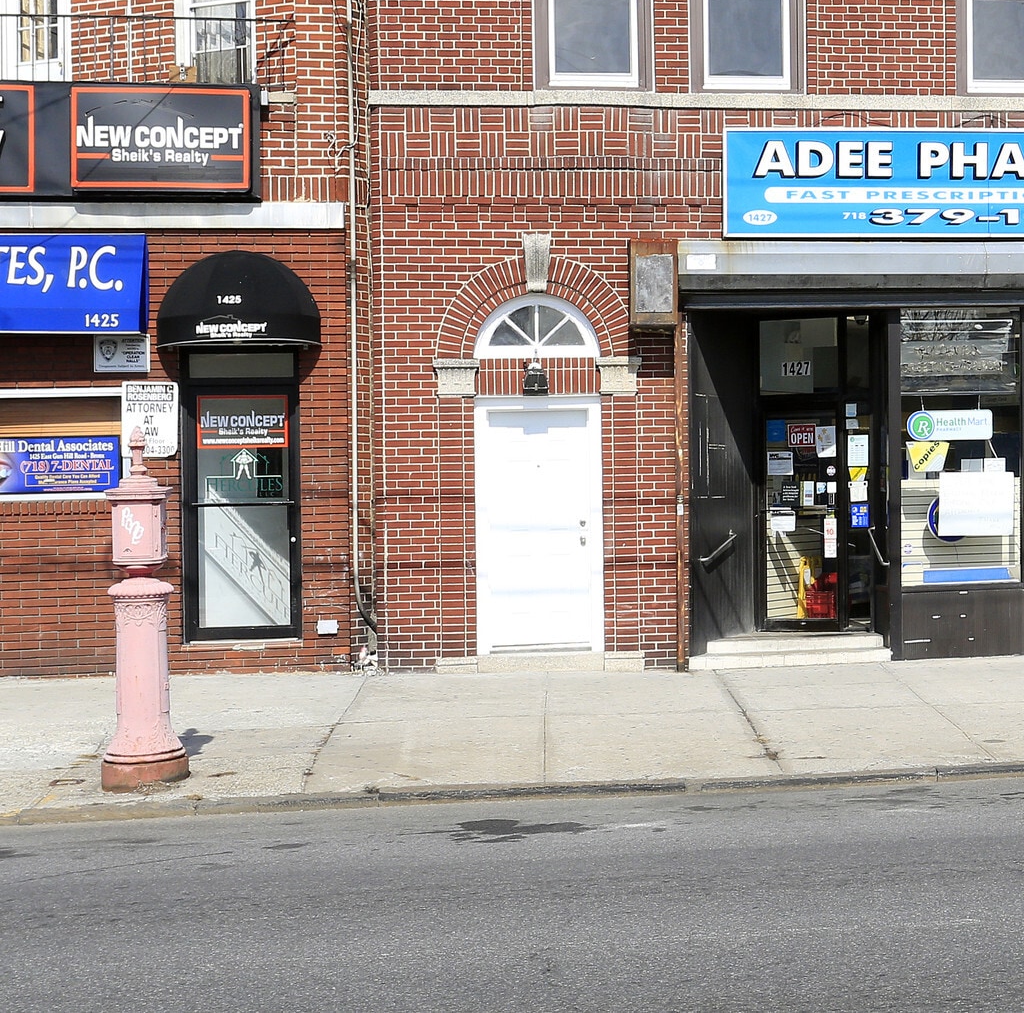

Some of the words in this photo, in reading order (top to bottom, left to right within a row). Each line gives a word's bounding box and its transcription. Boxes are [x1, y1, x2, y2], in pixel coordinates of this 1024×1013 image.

[76, 115, 132, 148] NEW
[134, 115, 243, 149] CONCEPT
[111, 148, 161, 162] Sheik's
[165, 149, 209, 166] Realty
[752, 140, 893, 179] ADEE
[786, 190, 851, 200] FAST
[748, 213, 772, 222] 1427
[842, 211, 867, 220] 718
[67, 245, 124, 291] P.C.
[217, 295, 241, 304] 1425
[84, 313, 119, 327] 1425
[196, 321, 219, 334] NEW
[220, 320, 267, 332] CONCEPT
[782, 362, 810, 375] 1427
[128, 385, 166, 393] BENJAMIN
[128, 393, 173, 401] ROSENBERG
[126, 403, 174, 413] ATTORNEY
[143, 415, 154, 425] AT
[200, 411, 229, 428] NEW
[230, 410, 285, 427] CONCEPT
[936, 417, 966, 426] Health
[967, 417, 988, 426] Mart
[144, 427, 159, 436] AW
[245, 428, 268, 436] Realty
[790, 433, 814, 444] OPEN
[18, 440, 55, 452] Dental
[57, 439, 114, 452] Associates
[914, 440, 940, 470] copies
[20, 460, 50, 474] (718)
[51, 459, 115, 472] 7-DENTAL
[207, 478, 283, 492] HERCULES
